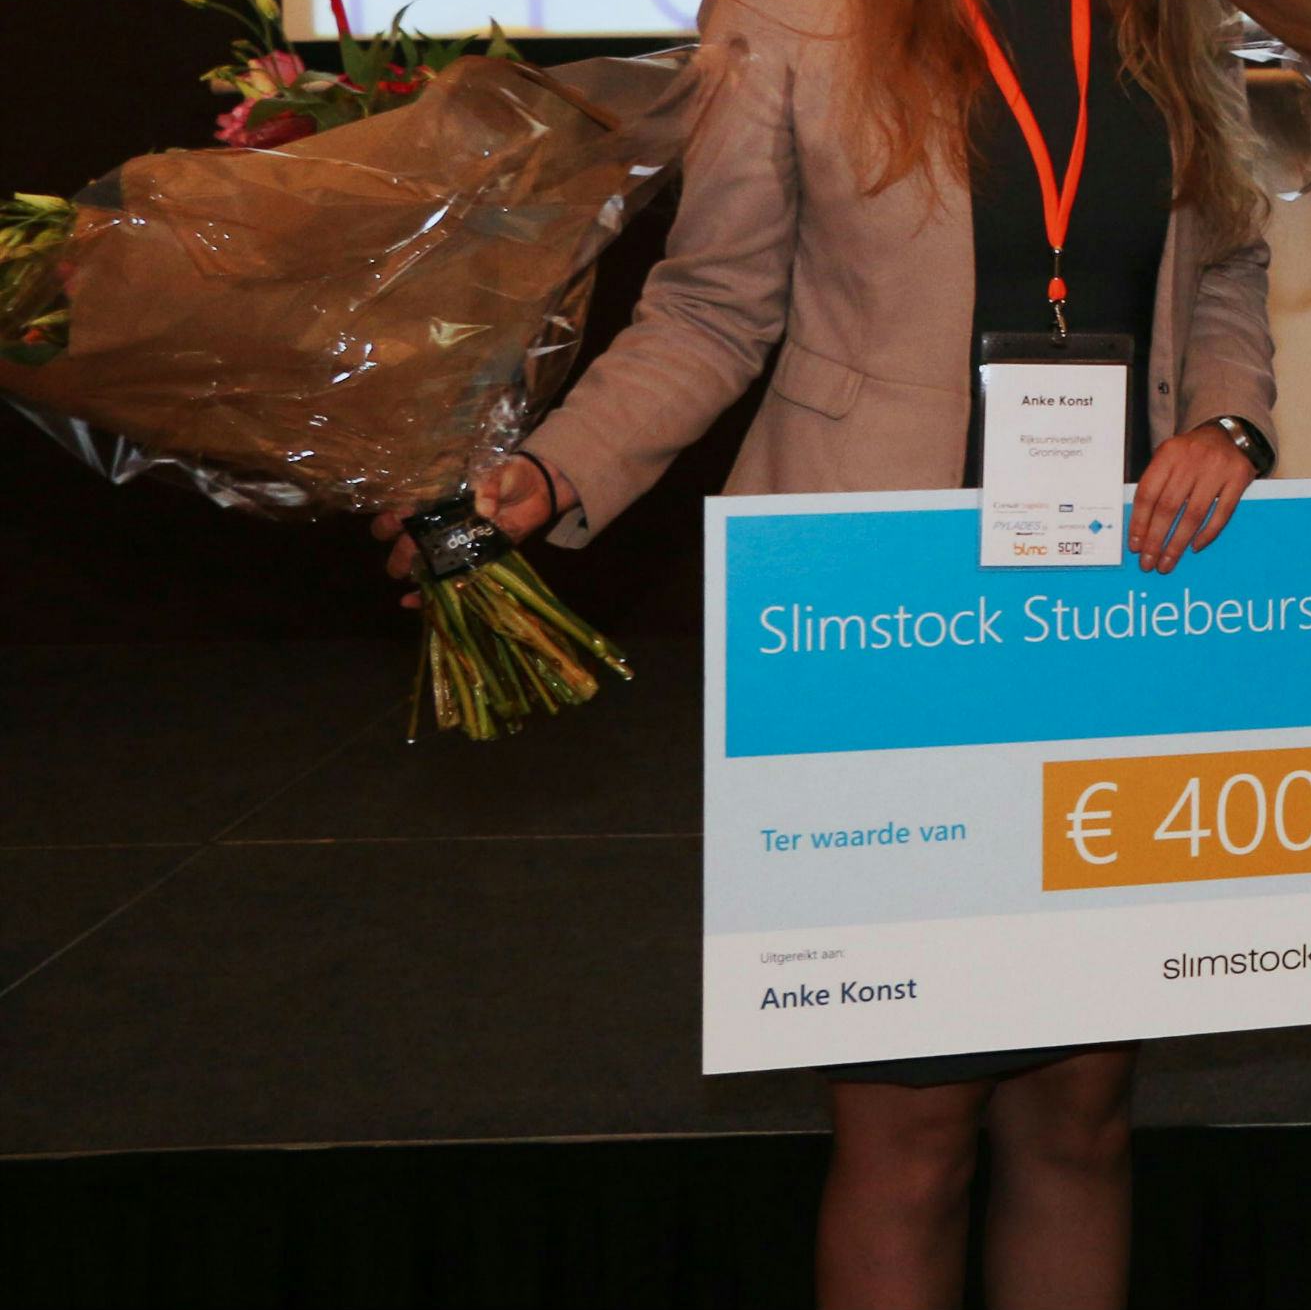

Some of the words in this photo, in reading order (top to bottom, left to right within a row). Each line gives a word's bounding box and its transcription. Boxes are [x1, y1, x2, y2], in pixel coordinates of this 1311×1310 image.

[1021, 395, 1055, 406] Anke
[1059, 395, 1093, 406] Konst
[759, 596, 1003, 654] Slimstock
[760, 829, 802, 852] Ter
[811, 821, 910, 849] waarde
[919, 822, 966, 843] van
[1066, 782, 1118, 865] €
[760, 949, 818, 965] Uitgereikt
[760, 984, 830, 1010] Anke
[841, 978, 917, 1004] Konst
